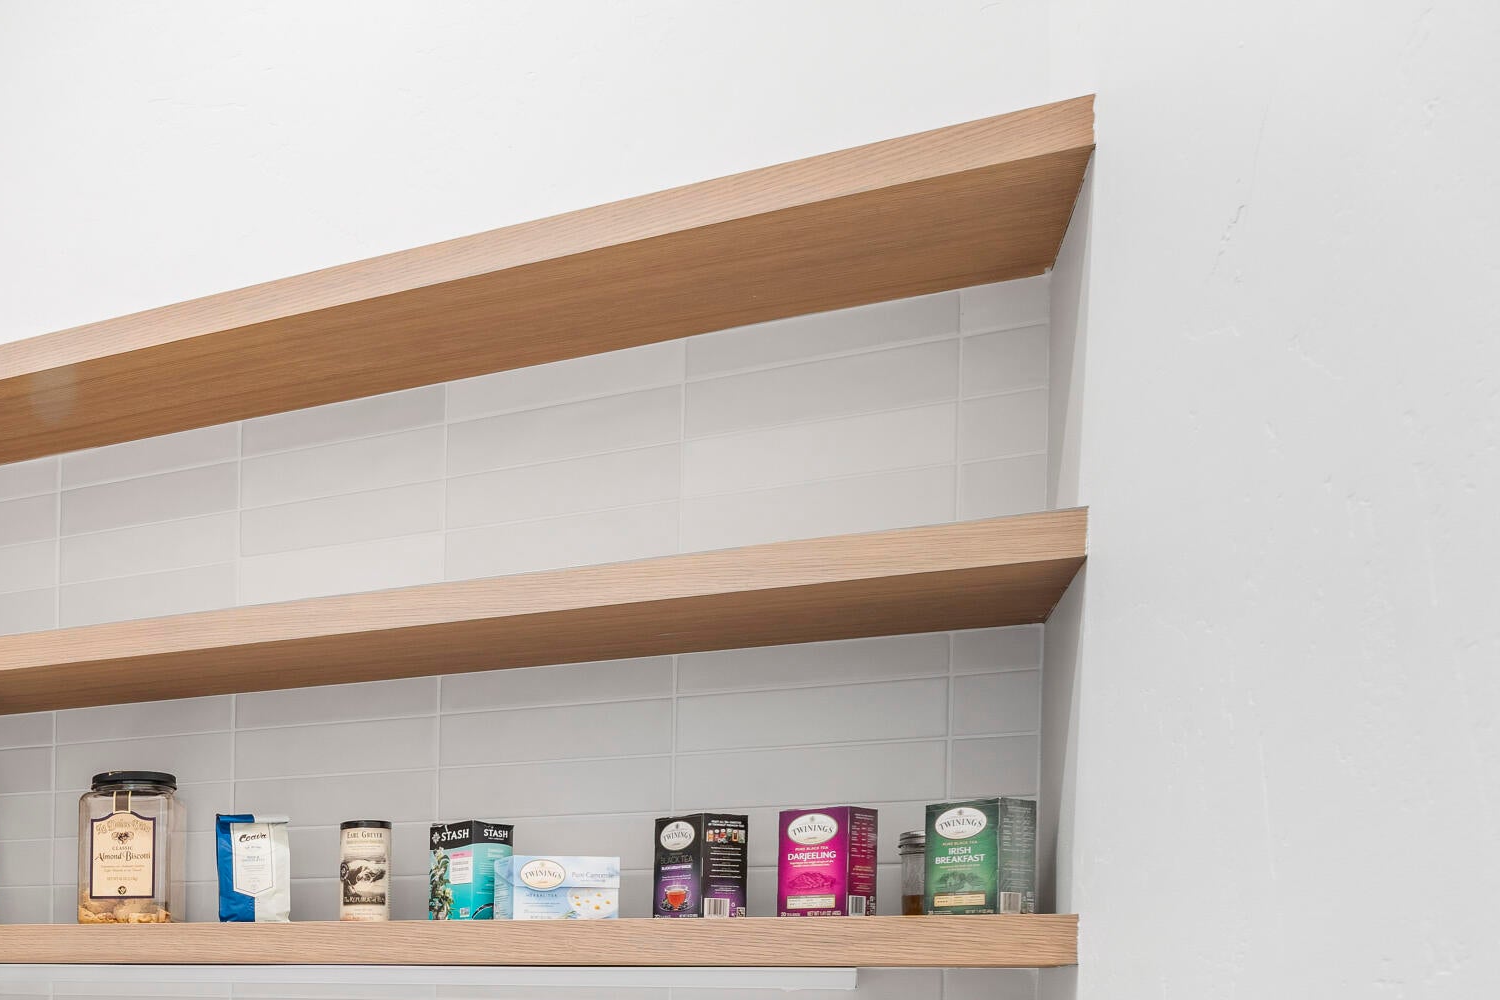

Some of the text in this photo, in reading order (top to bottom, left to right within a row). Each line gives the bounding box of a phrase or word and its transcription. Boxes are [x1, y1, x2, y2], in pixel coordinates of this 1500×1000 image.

[939, 818, 983, 830] TWININGS
[441, 829, 470, 841] STASH
[483, 828, 508, 838] STASH
[792, 824, 834, 836] TWININGS
[663, 831, 692, 842] TWININGS
[94, 851, 151, 861] Almond Biscotti
[787, 850, 837, 861] DARJEELING
[948, 846, 972, 855] IRISH
[935, 853, 986, 864] BREAKFAST
[524, 869, 562, 880] TWININGS
